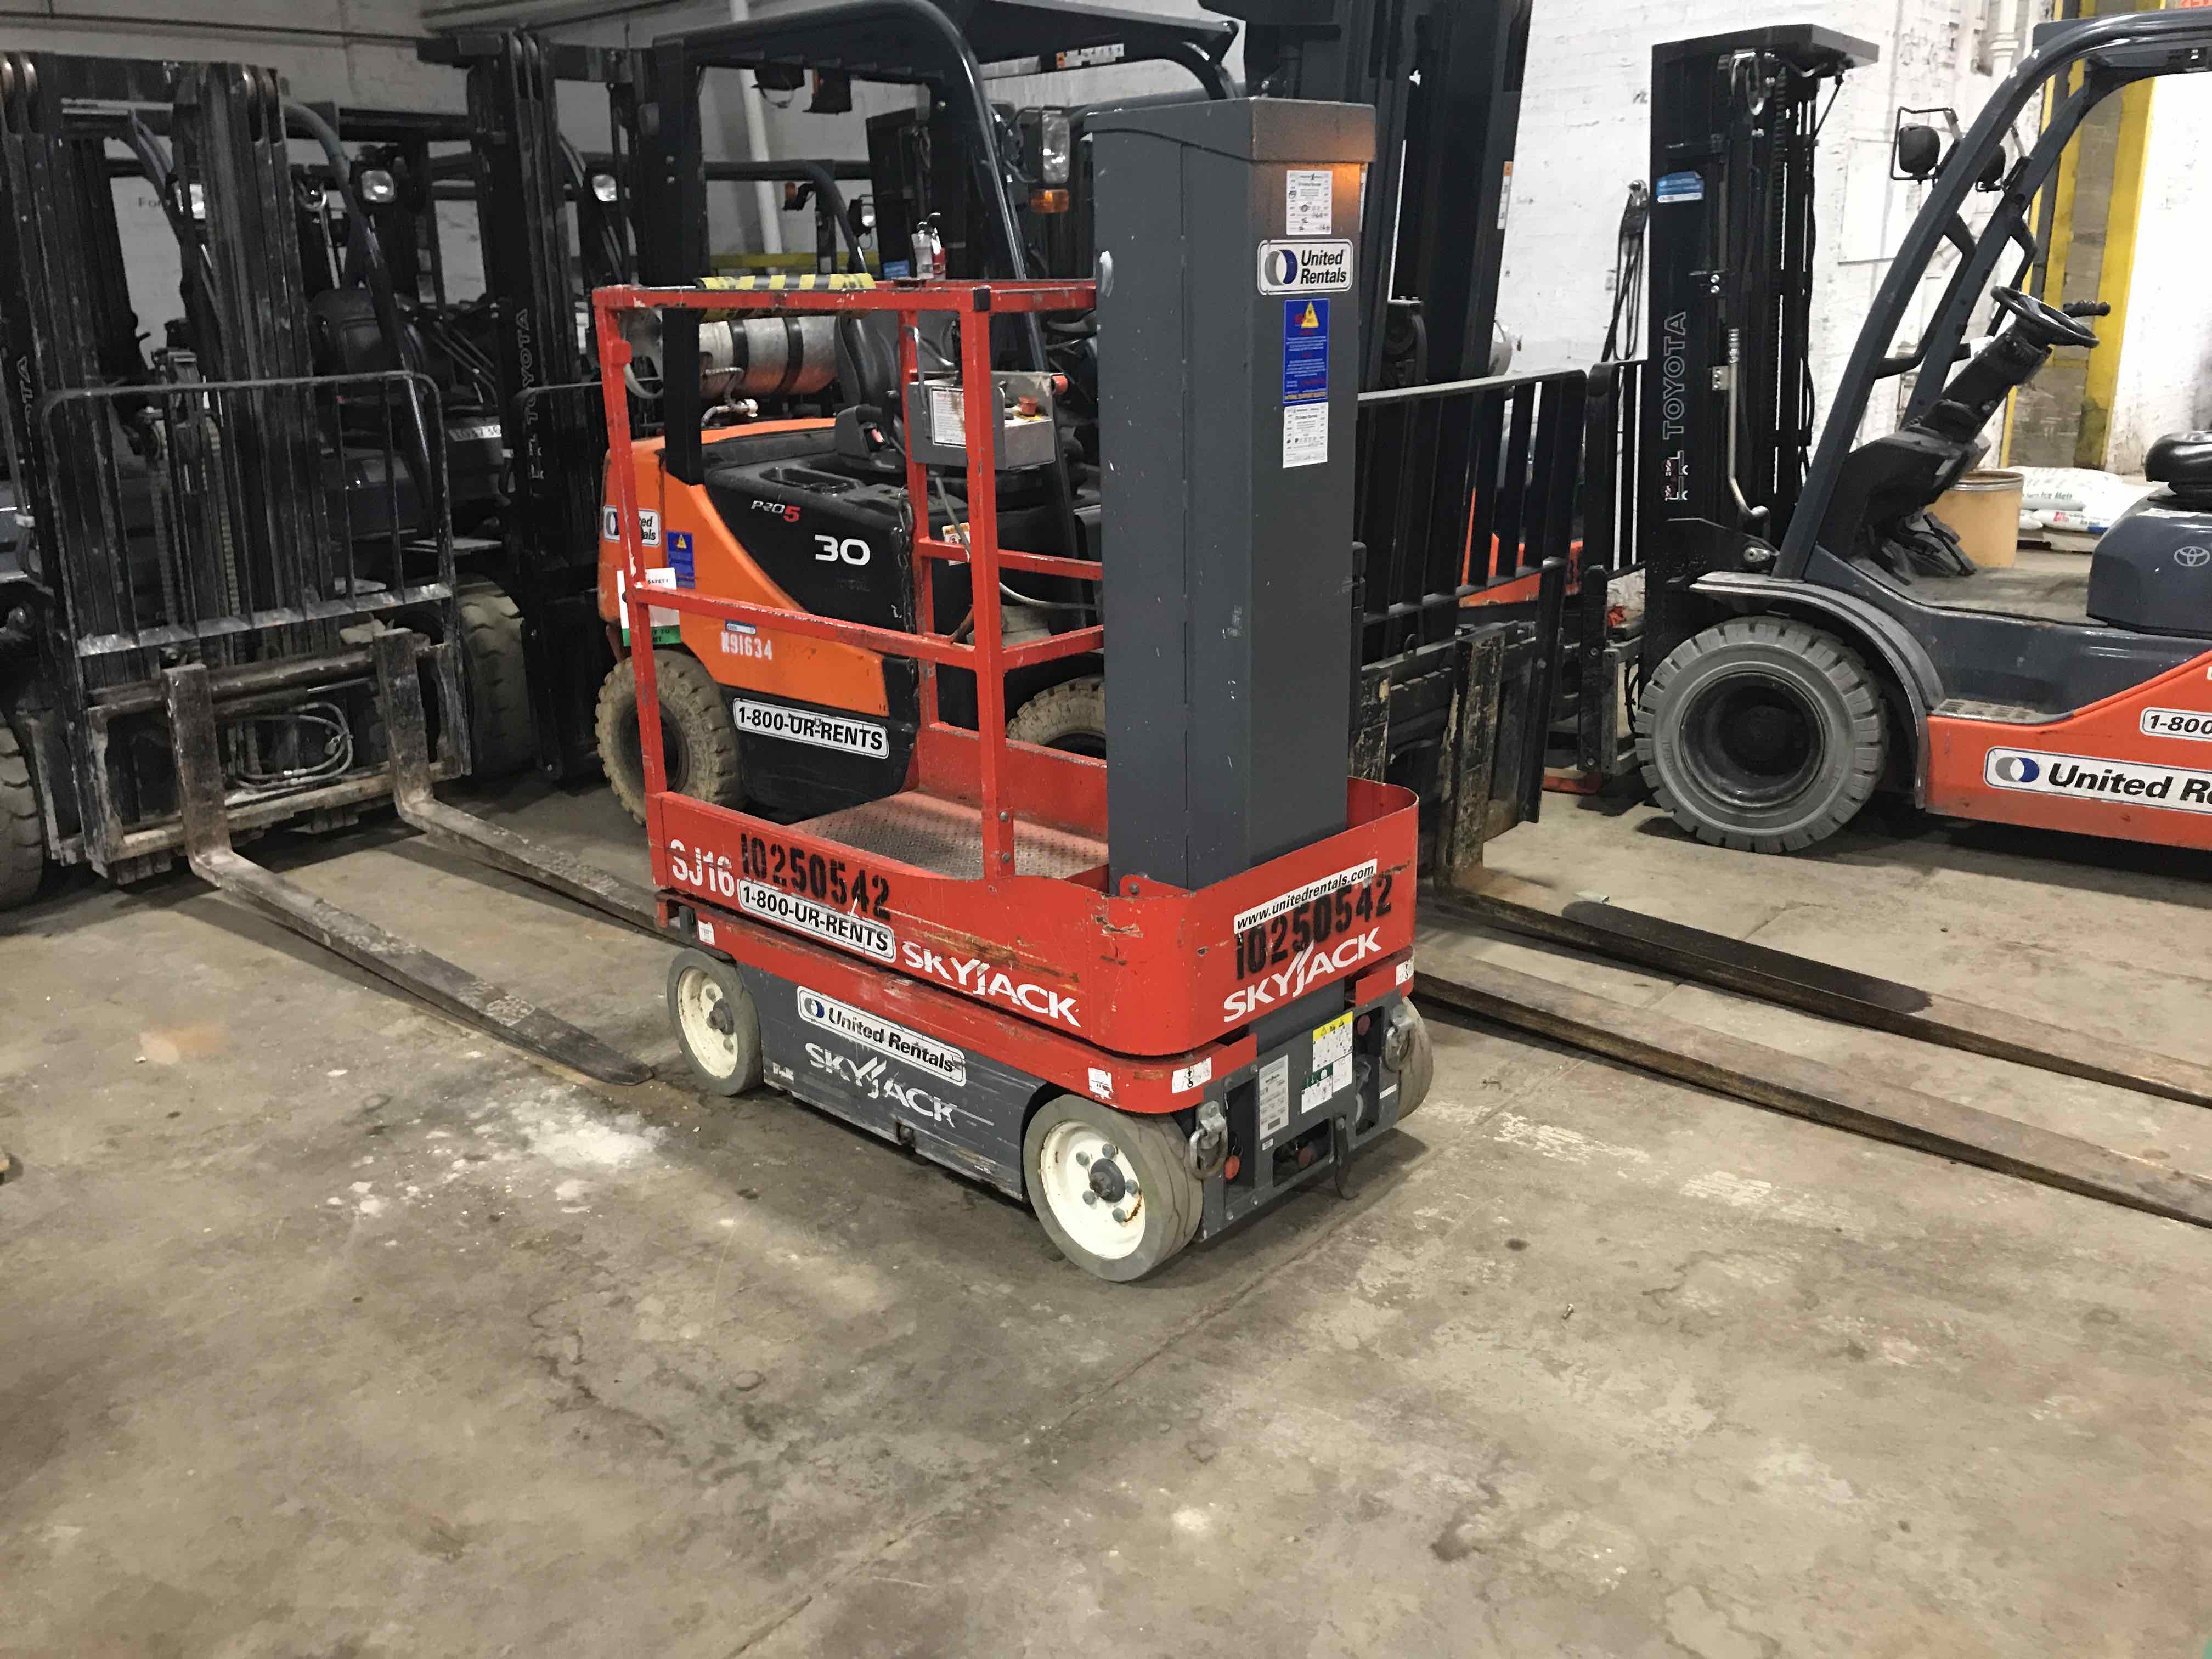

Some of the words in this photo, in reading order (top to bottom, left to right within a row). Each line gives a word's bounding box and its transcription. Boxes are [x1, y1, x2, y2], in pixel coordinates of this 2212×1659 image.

[1300, 267, 1347, 284] Rentals
[1301, 249, 1344, 266] United
[1663, 311, 1686, 440] TOYOTA
[815, 534, 871, 566] 30
[738, 706, 883, 751] 1-800-UR-RENTS
[2048, 762, 2174, 799] United
[670, 839, 735, 898] SJ16
[743, 886, 889, 952] 1-800-UR-RENTS
[1237, 865, 1374, 930] www.unitedrentals.com
[828, 1007, 884, 1044] United
[888, 1033, 955, 1073] Rentals
